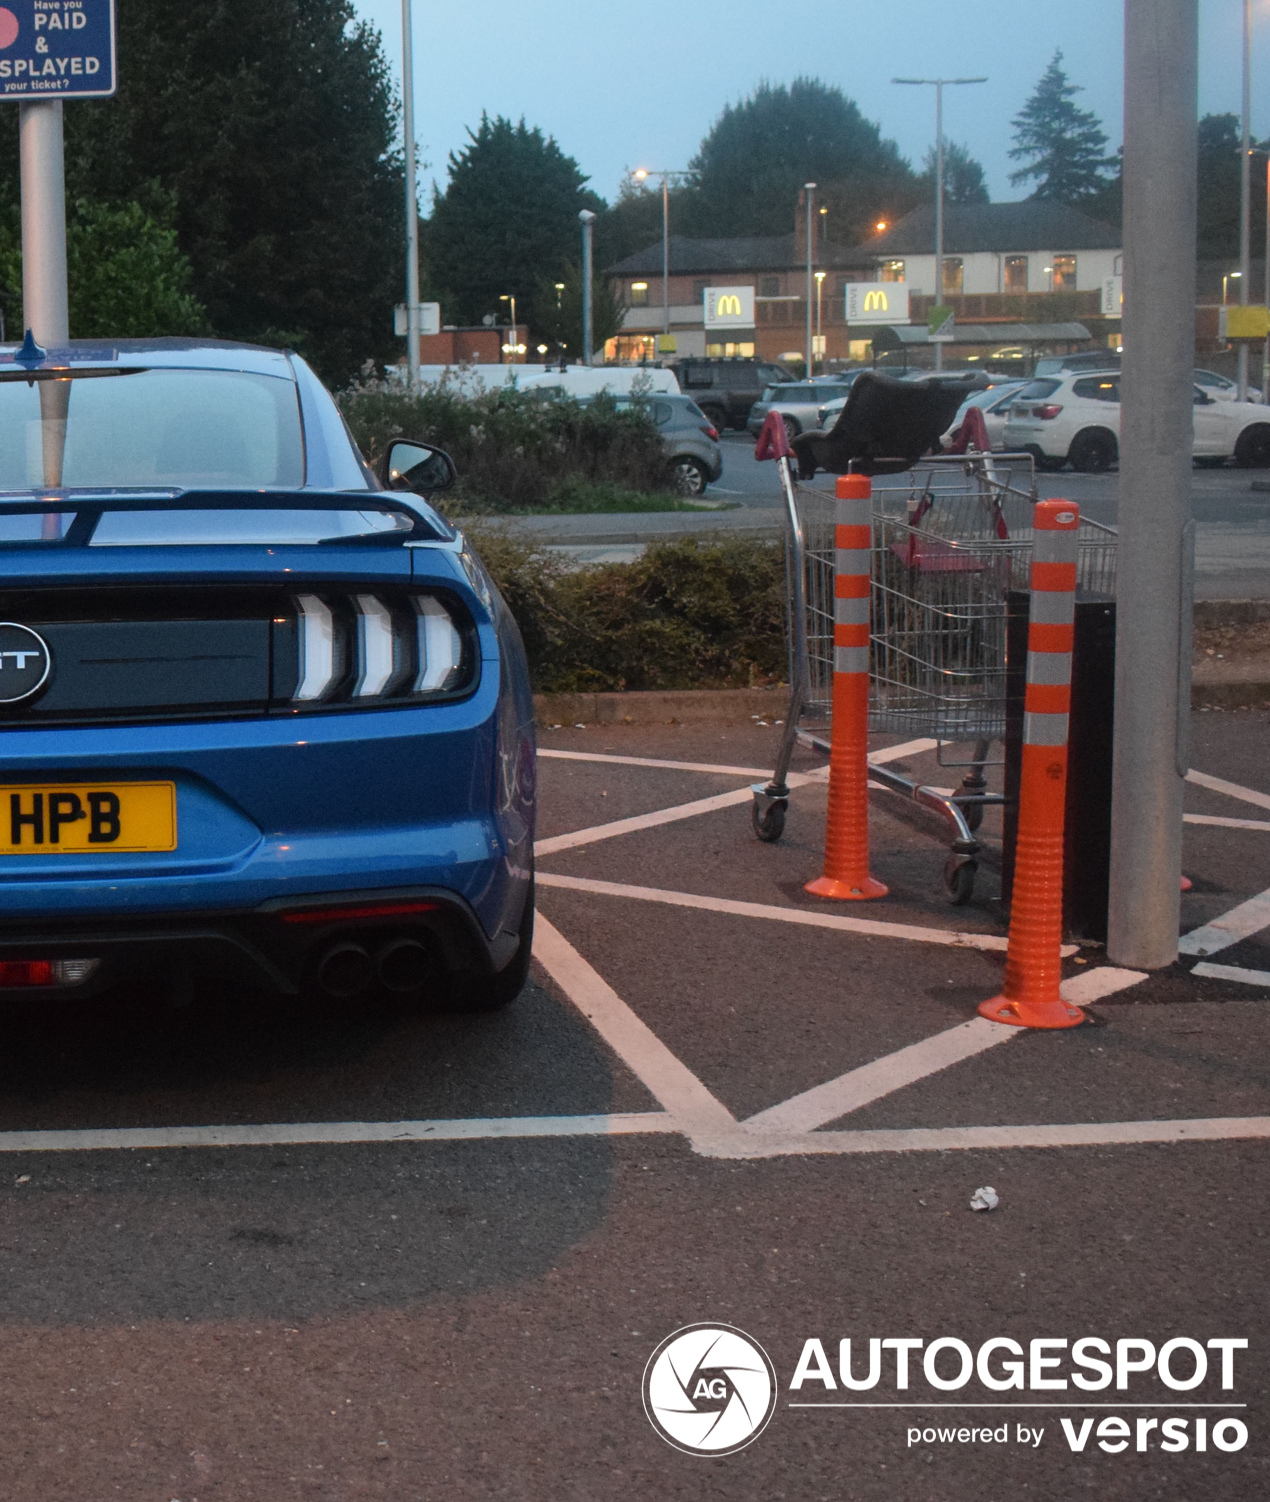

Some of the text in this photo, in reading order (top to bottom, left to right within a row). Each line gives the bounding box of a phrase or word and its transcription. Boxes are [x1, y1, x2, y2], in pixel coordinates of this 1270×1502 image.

[34, 0, 82, 11] Have you
[34, 12, 87, 30] PAID
[35, 36, 49, 53] &
[4, 82, 28, 92] your
[708, 291, 716, 321] DRIVE
[10, 792, 121, 844] HPB
